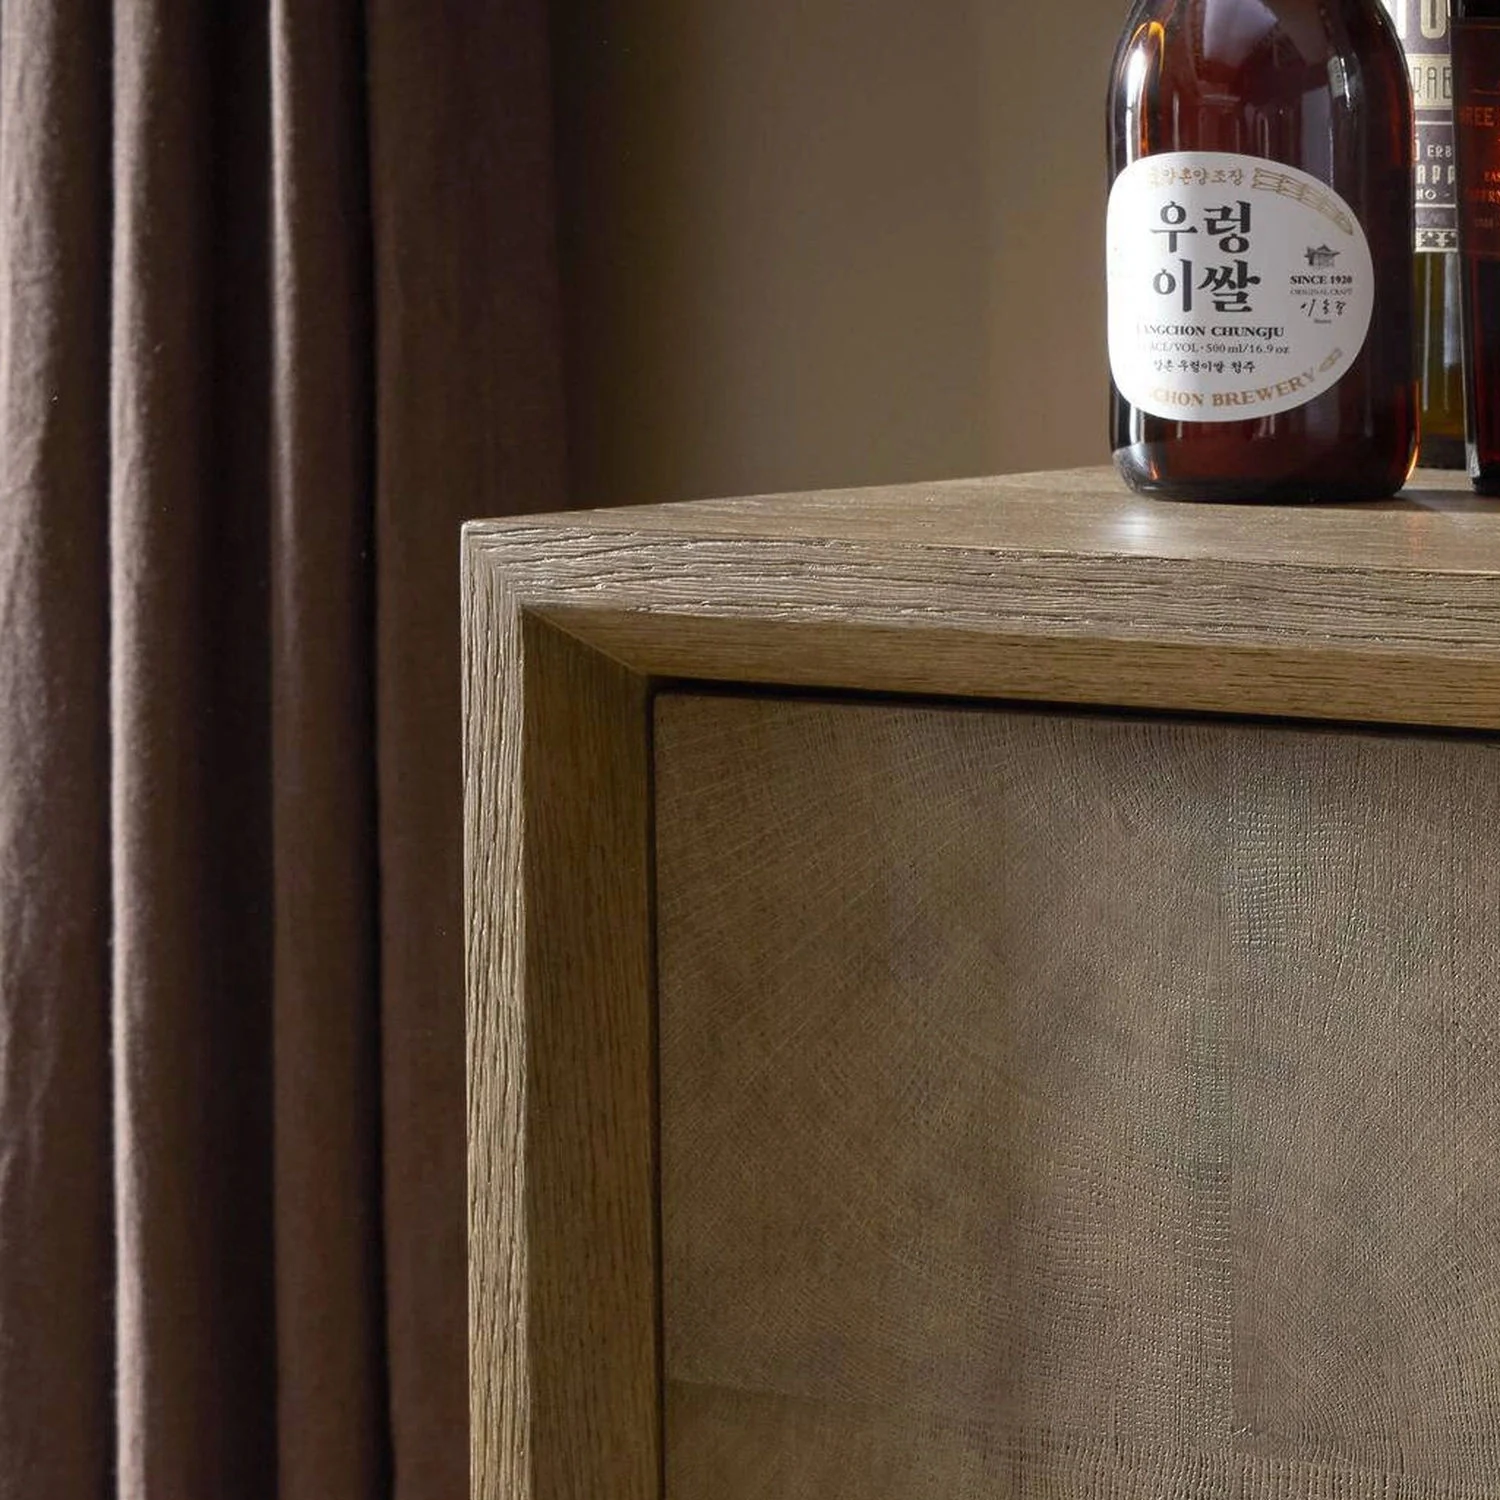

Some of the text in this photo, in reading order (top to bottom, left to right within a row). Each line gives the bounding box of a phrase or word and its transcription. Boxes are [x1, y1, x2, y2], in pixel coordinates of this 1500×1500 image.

[1150, 200, 1252, 254] 우렁
[1152, 258, 1261, 313] 이쌀
[1290, 275, 1328, 285] SINCE
[1211, 326, 1285, 339] CHUNGJU
[1150, 366, 1316, 407] CHON BREWERY
